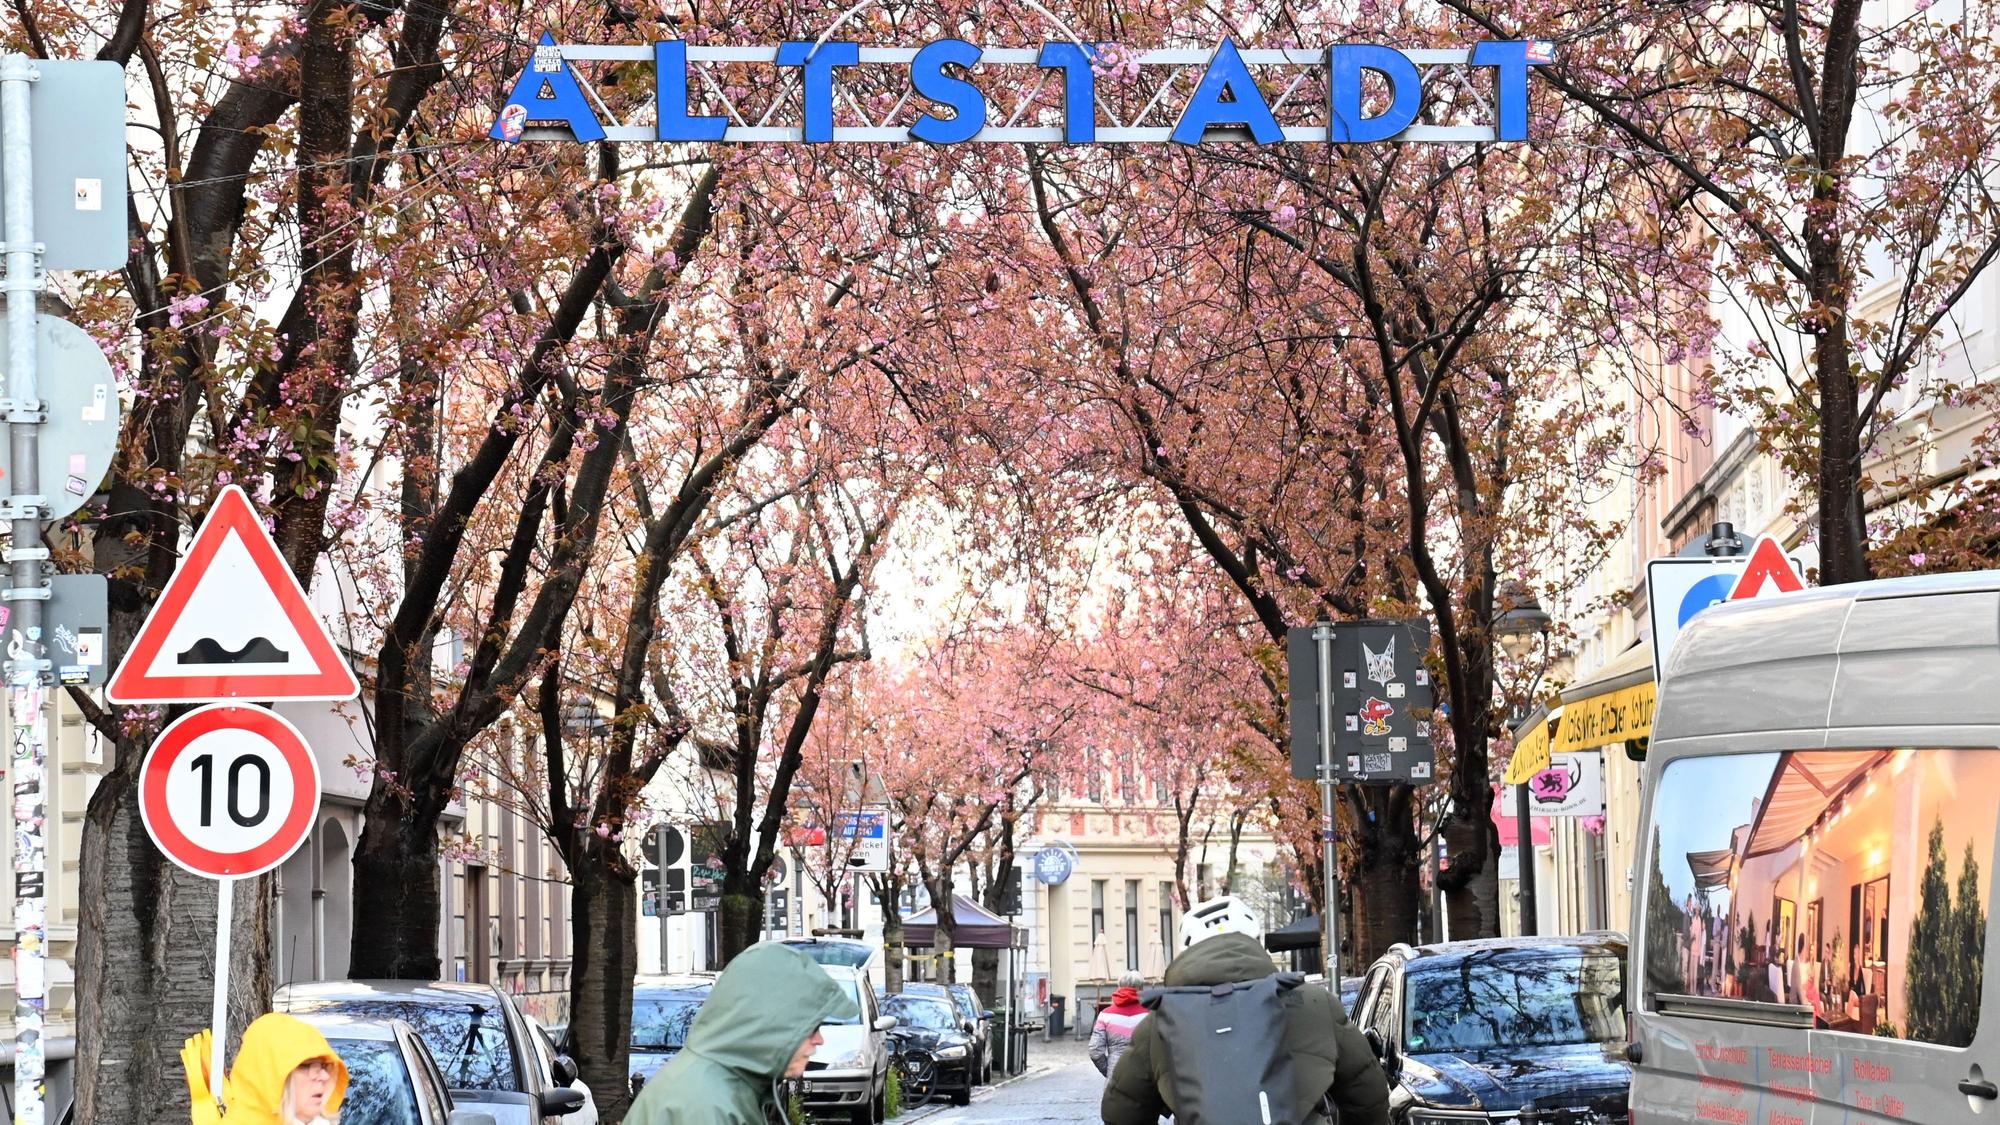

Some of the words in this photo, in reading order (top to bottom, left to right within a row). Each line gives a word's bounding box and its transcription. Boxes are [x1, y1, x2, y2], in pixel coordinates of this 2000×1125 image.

[489, 30, 1555, 145] ALTSTADT
[191, 753, 271, 828] 10
[858, 841, 883, 849] icket
